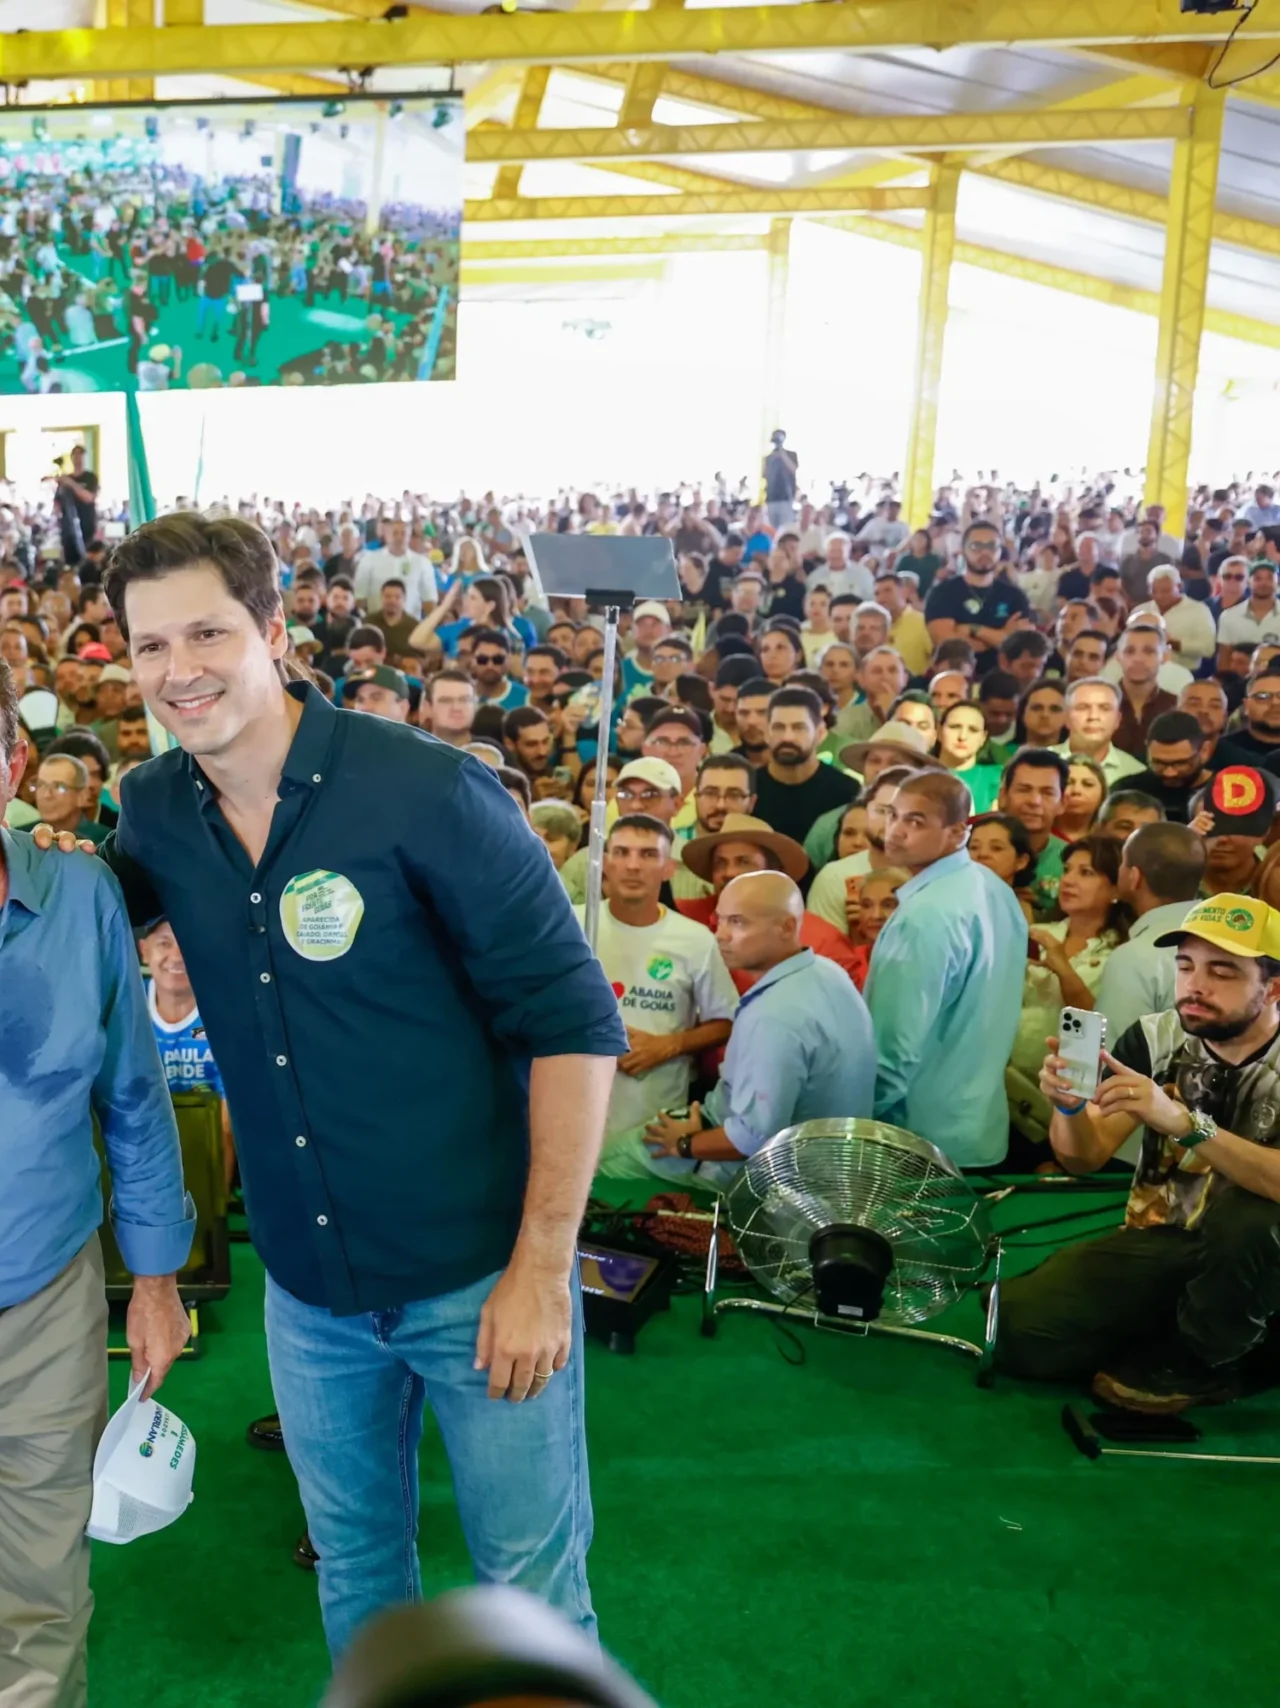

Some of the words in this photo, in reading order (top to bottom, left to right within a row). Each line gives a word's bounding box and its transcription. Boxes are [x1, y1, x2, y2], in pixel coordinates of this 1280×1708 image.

[1222, 773, 1257, 808] D
[629, 985, 673, 1000] ABADIA
[622, 996, 637, 1008] DE
[164, 1048, 214, 1065] PAULA
